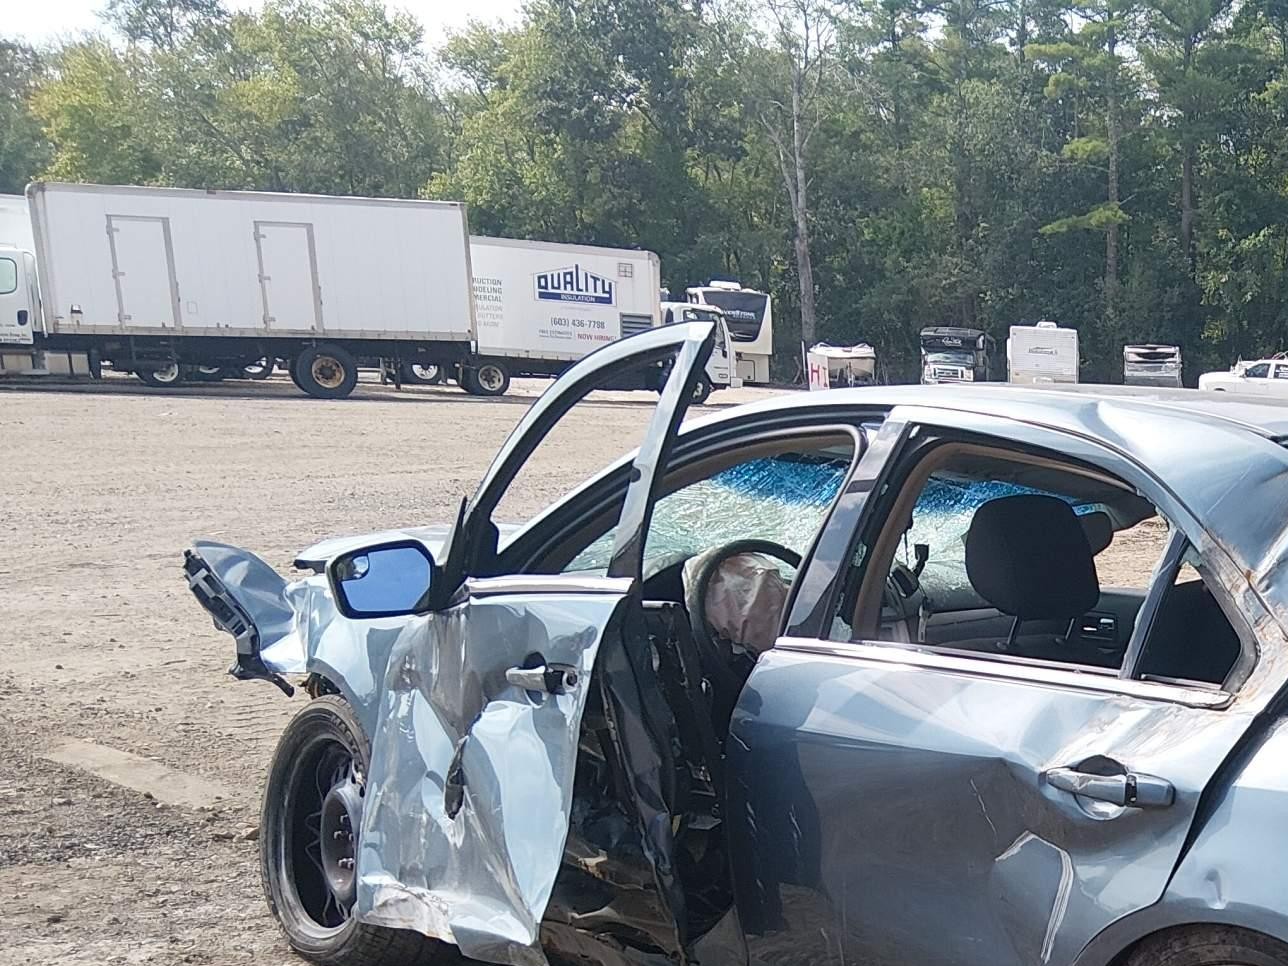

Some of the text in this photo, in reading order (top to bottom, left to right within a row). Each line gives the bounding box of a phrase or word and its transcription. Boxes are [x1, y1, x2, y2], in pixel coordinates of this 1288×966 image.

[537, 263, 612, 300] QUALITY
[560, 293, 596, 303] INSULATION
[550, 316, 570, 328] (603)
[577, 333, 593, 341] NOW
